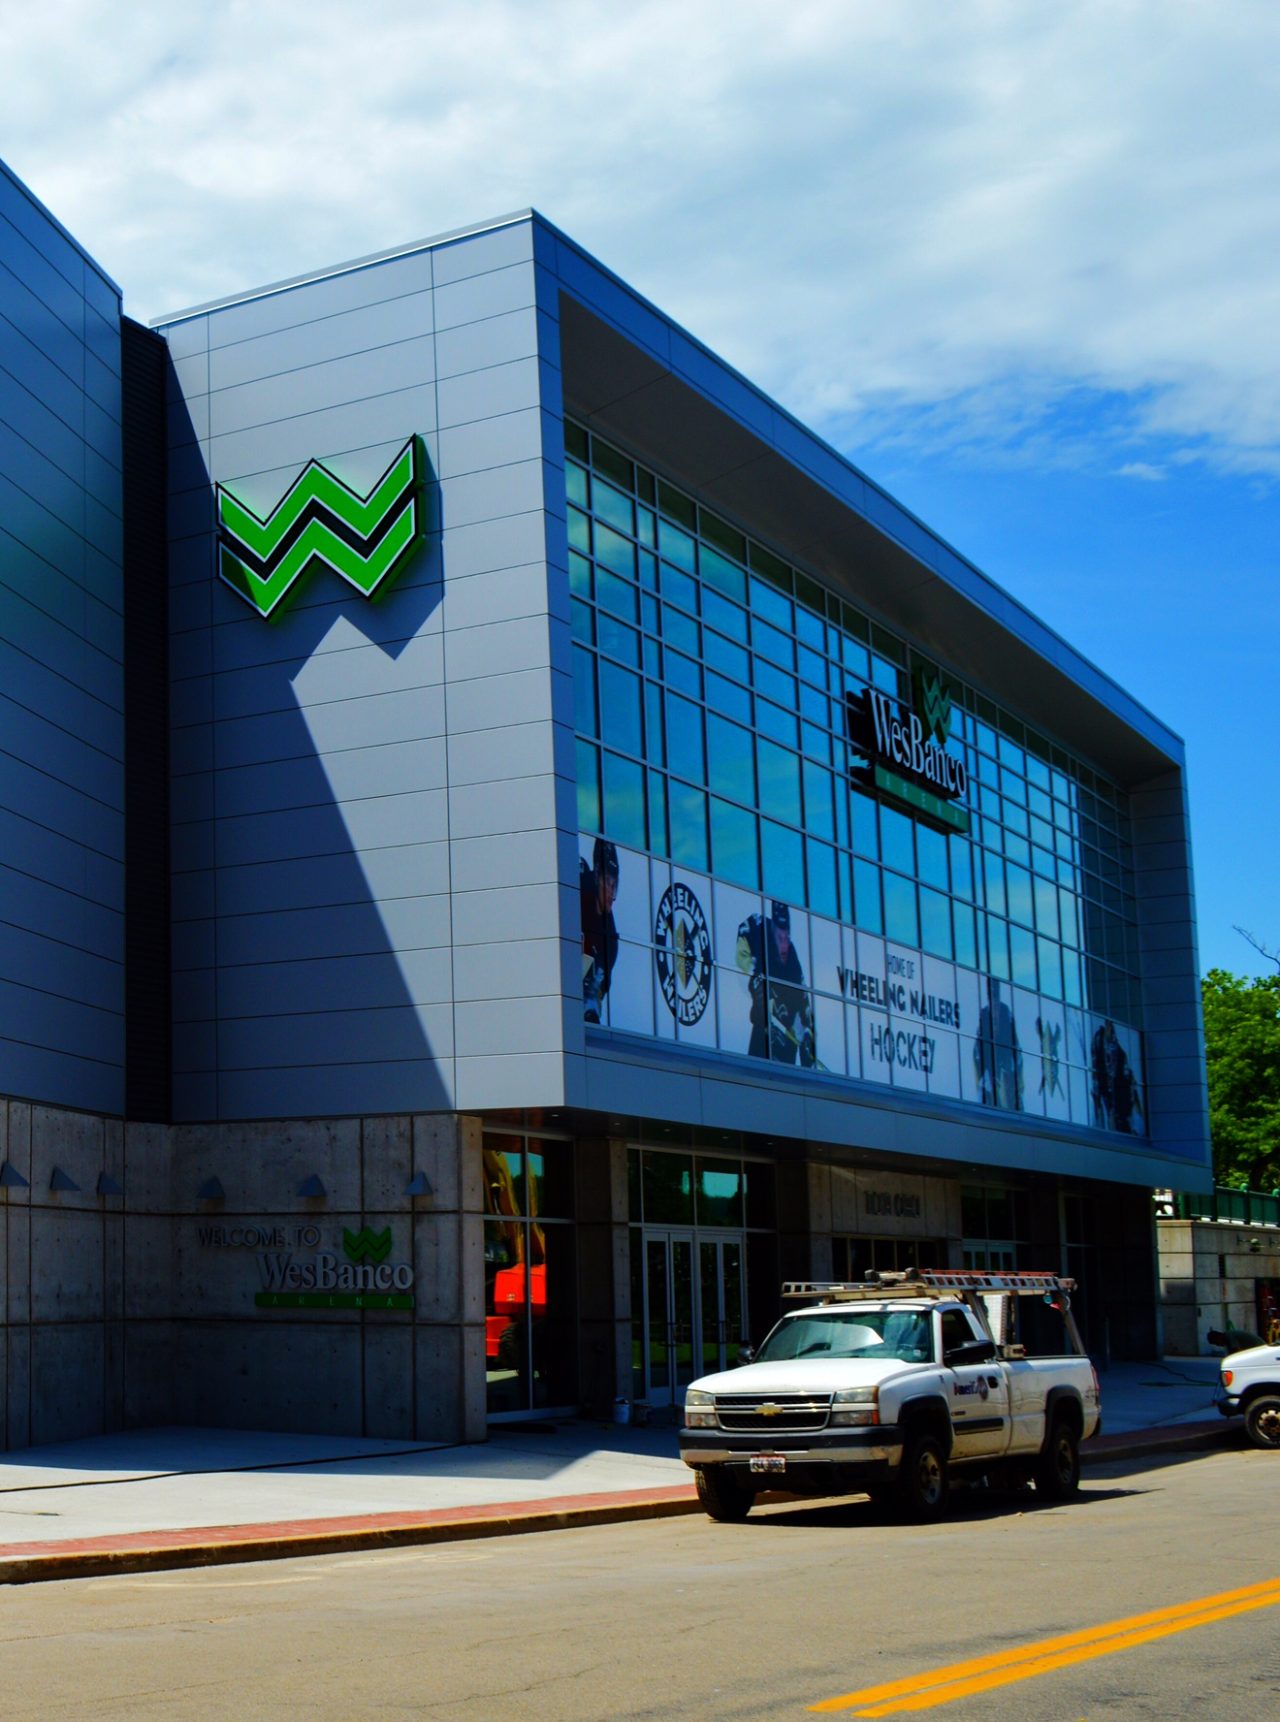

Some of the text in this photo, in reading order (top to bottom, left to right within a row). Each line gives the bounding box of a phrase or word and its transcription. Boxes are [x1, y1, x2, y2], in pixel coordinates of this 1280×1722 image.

[869, 688, 967, 797] WesBanco
[909, 988, 961, 1030] NAILERS
[870, 1022, 936, 1074] HOCKEY
[198, 1224, 322, 1248] WELCOME TO
[256, 1252, 415, 1290] WesBanco
